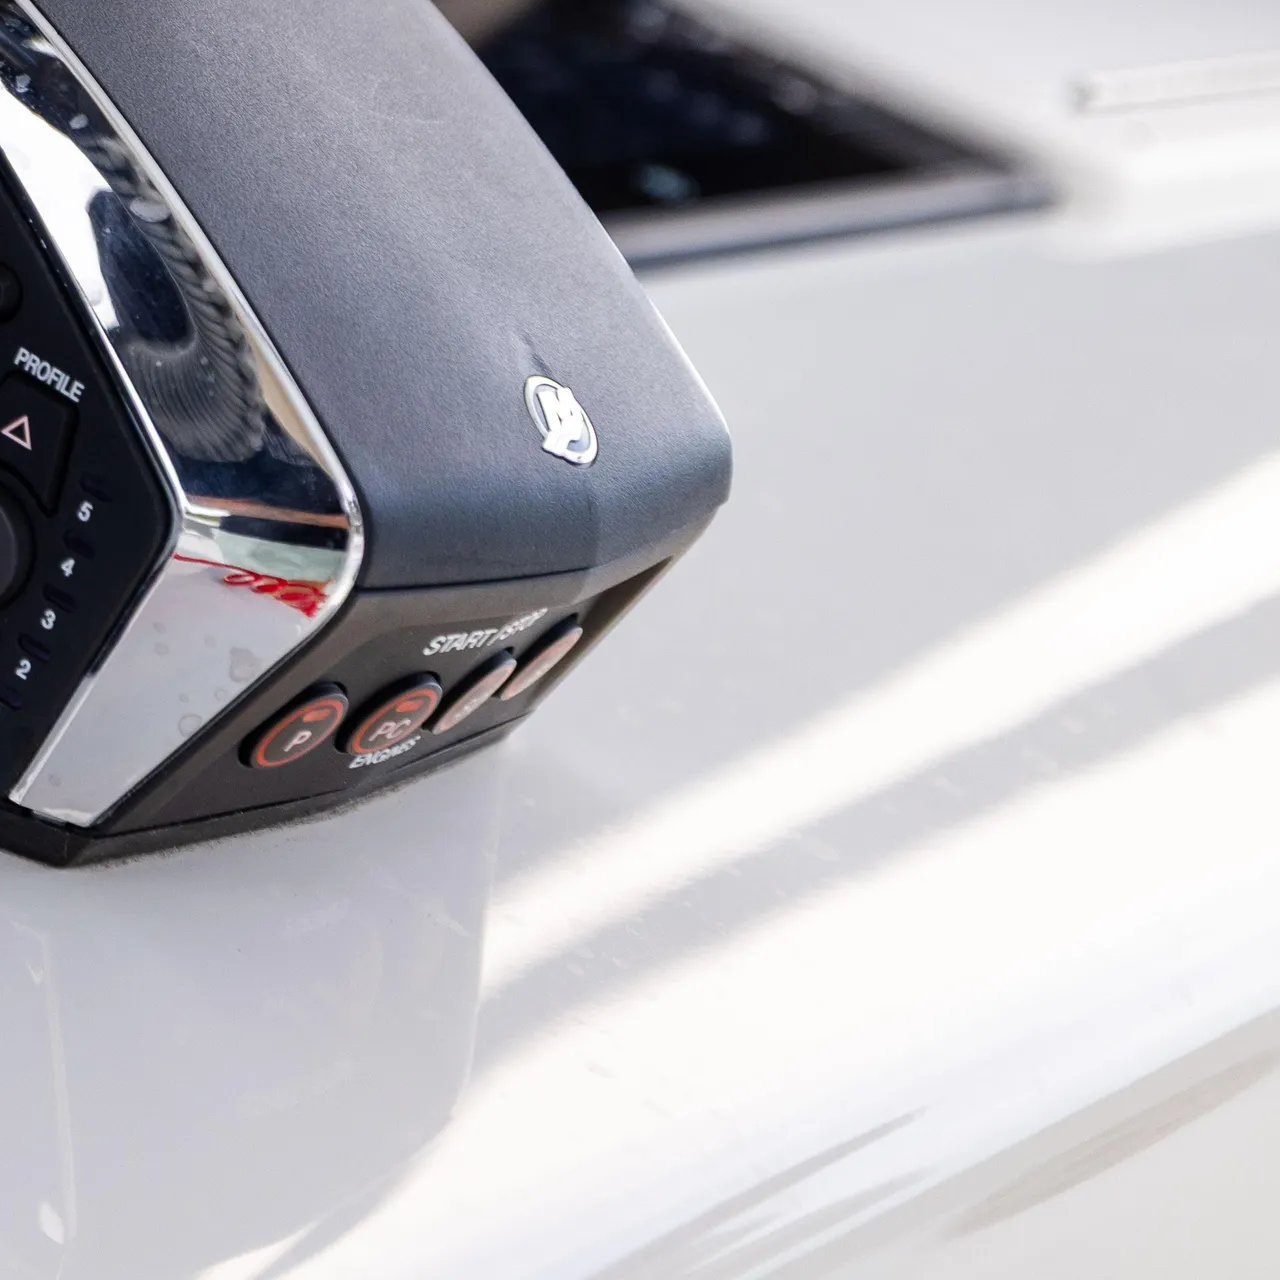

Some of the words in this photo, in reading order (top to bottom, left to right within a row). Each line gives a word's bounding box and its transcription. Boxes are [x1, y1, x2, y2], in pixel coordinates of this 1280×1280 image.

[14, 347, 85, 404] PROFILE
[77, 501, 94, 521] 5
[61, 558, 75, 577] 4
[40, 610, 56, 629] 3
[15, 660, 32, 680] 2
[368, 718, 412, 742] PC
[283, 730, 313, 753] P
